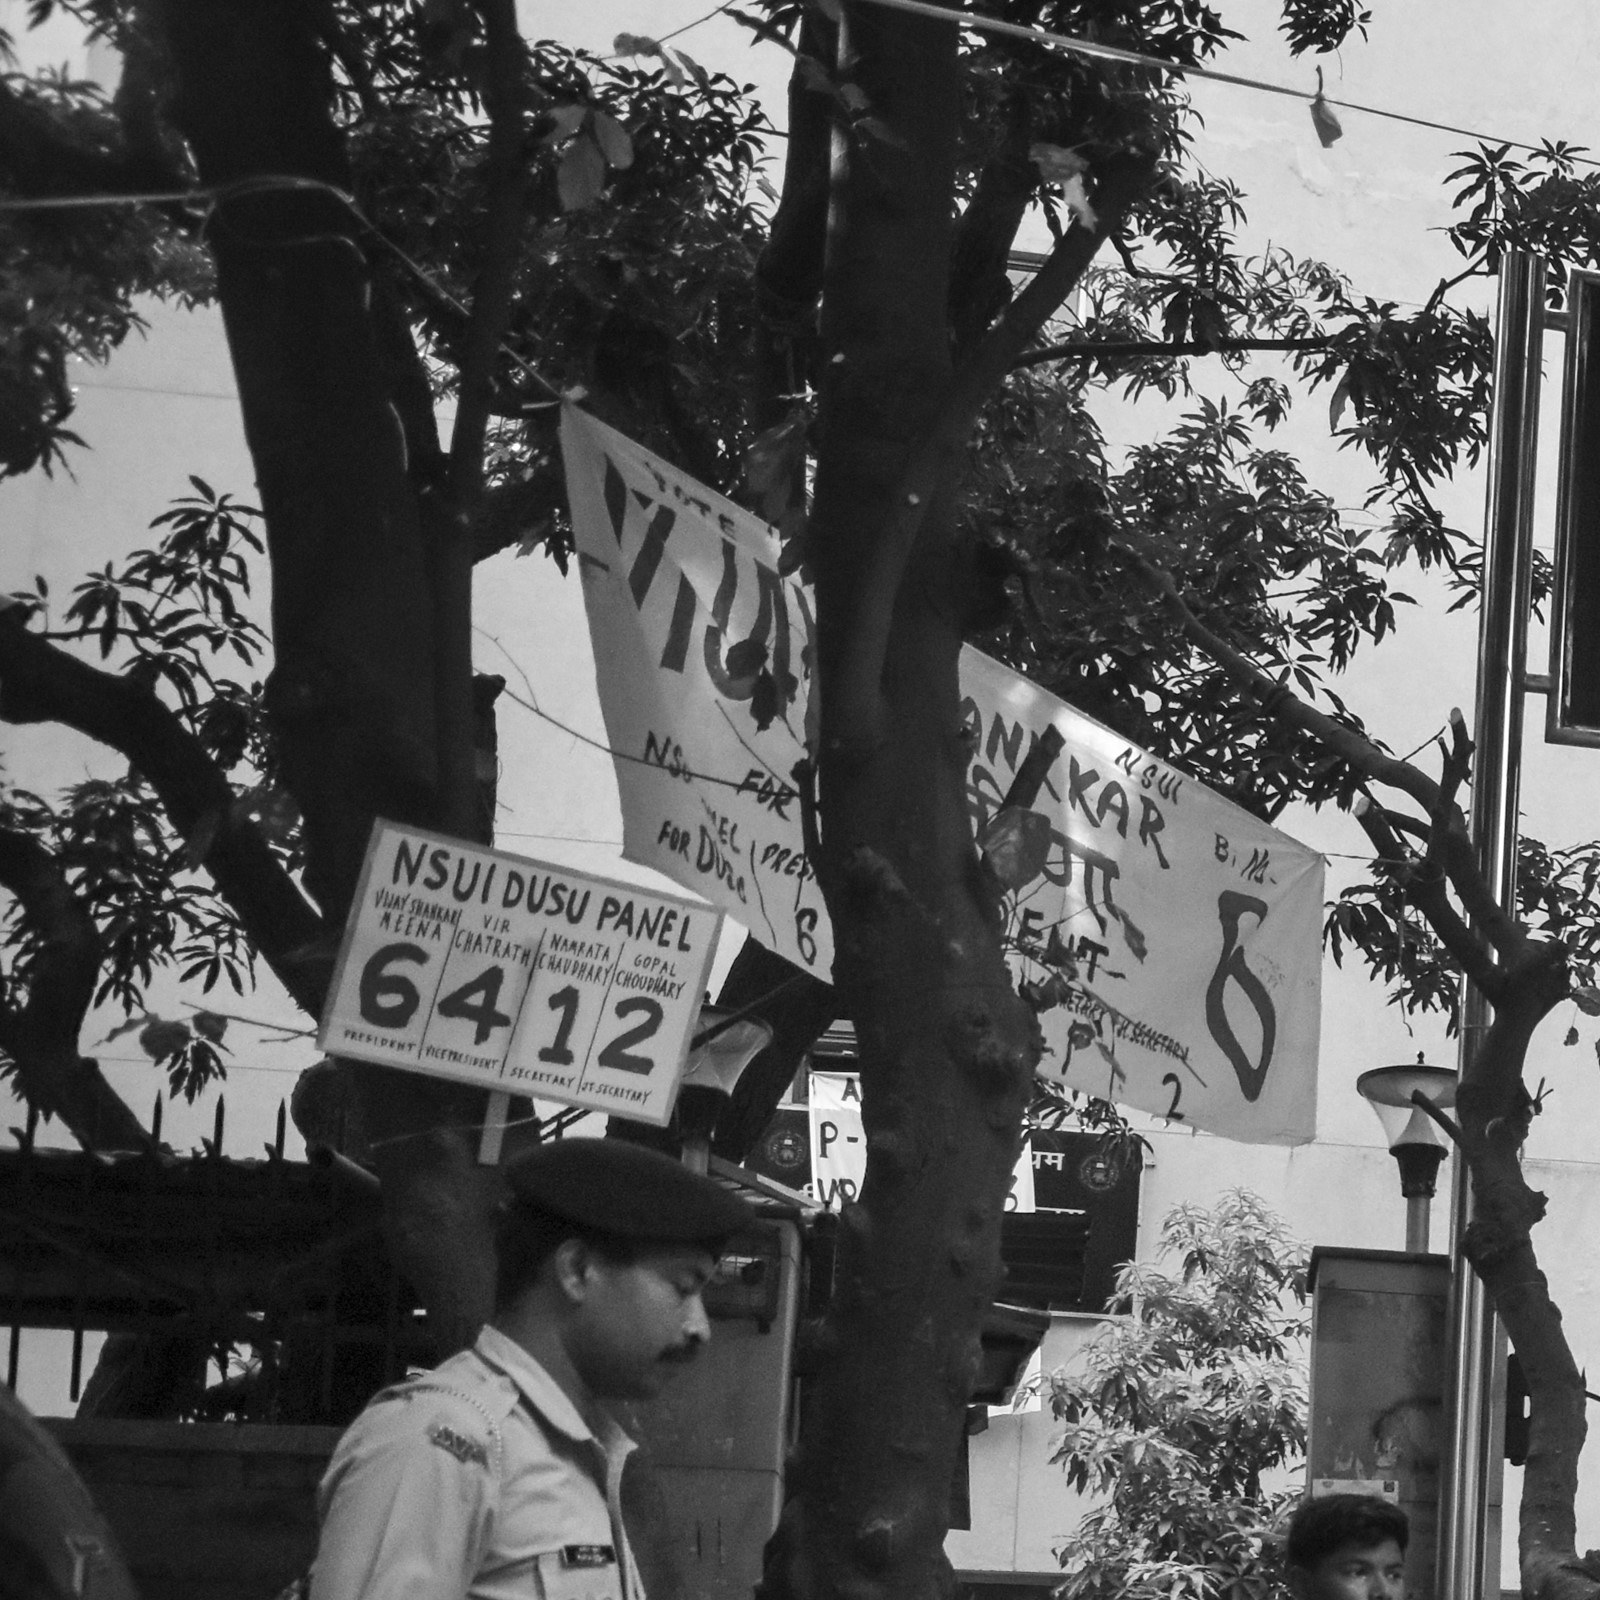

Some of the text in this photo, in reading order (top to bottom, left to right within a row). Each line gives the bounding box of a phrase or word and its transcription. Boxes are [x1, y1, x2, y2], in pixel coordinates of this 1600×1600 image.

[1113, 746, 1184, 807] NSUI
[391, 838, 693, 953] NSUI DUSU PANEL
[406, 895, 461, 927] SHANKAR
[379, 912, 443, 942] MEENA
[482, 913, 512, 934] VIR
[453, 928, 532, 968] CHATRATH
[549, 932, 611, 962] NAMRATA
[537, 953, 613, 988] CHAUDHARY
[632, 952, 678, 979] GOPAL
[358, 941, 431, 1030] 6
[614, 969, 686, 1001] CHOUDHARY
[436, 964, 513, 1047] 4
[343, 1028, 418, 1054] PRESIDENT
[537, 983, 581, 1066] 1
[597, 995, 665, 1077] 2
[510, 1066, 577, 1090] SECRETARY
